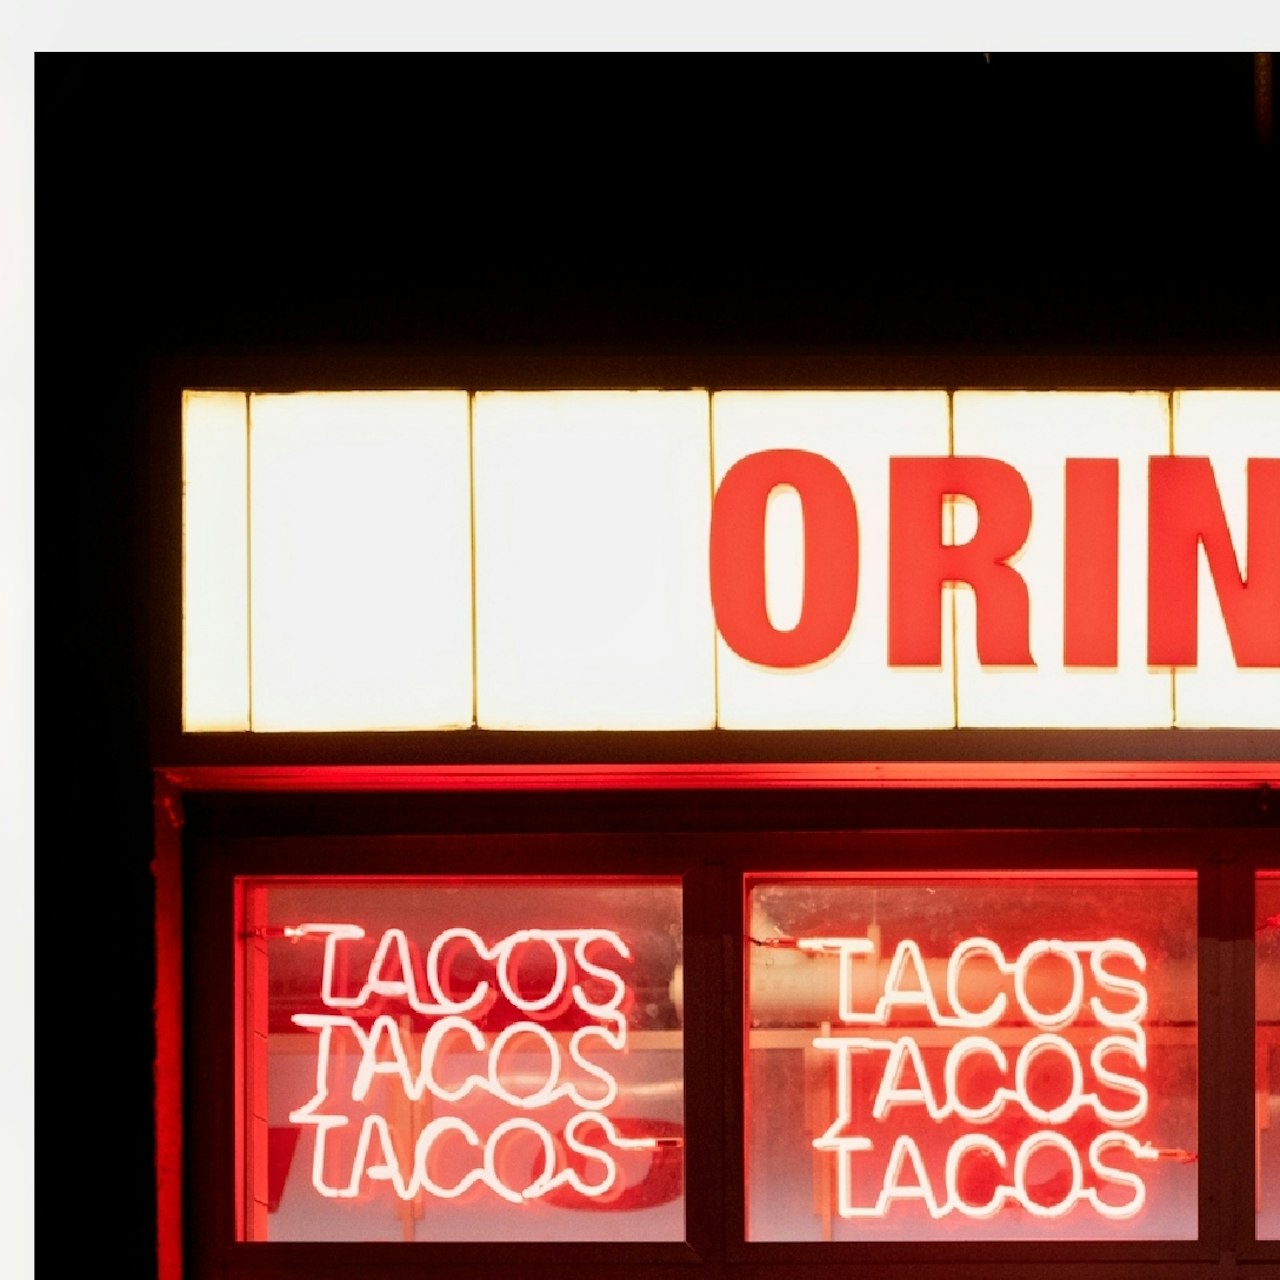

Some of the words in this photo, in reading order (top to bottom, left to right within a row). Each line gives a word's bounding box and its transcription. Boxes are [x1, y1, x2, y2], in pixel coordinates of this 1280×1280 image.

[297, 923, 631, 1016] TACOS
[797, 937, 1147, 1029] TACOS
[292, 1014, 626, 1109] TACOS
[813, 1035, 1148, 1122] TACOS
[290, 1112, 654, 1203] TACOS
[813, 1131, 1158, 1219] TACOS
